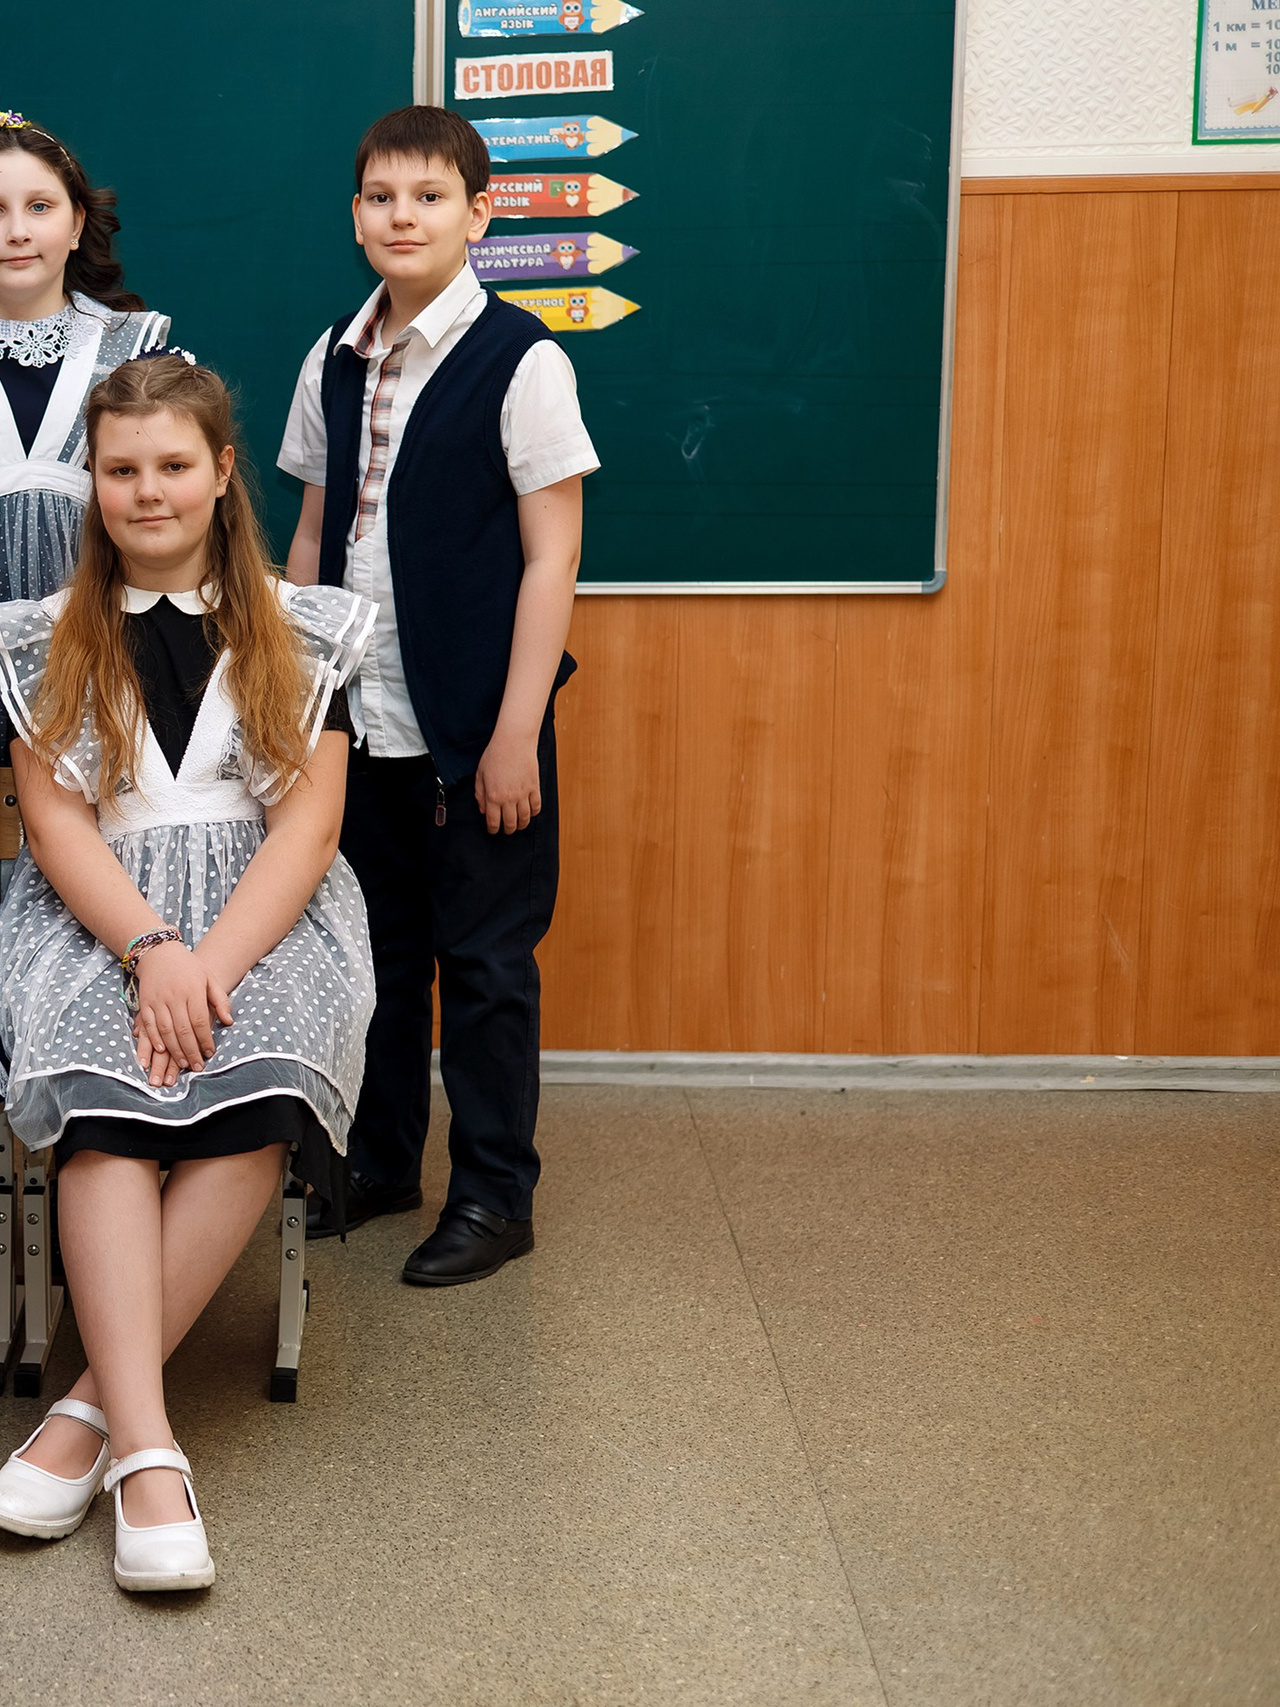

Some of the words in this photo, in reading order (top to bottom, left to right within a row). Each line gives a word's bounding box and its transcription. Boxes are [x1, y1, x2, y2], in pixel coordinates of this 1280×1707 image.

[475, 4, 558, 17] АНГЛИЙСКИЙ
[500, 19, 534, 29] ЯЗЫК
[1213, 21, 1220, 32] 1
[1212, 41, 1219, 51] 1
[462, 58, 607, 94] СТОЛОВАЯ
[483, 135, 560, 146] АТЕМАТИКА
[493, 196, 531, 208] ЯЗЫК
[470, 243, 552, 257] ФИЗИЧЕСКАЯ
[476, 257, 545, 269] КУЛЬТУРА
